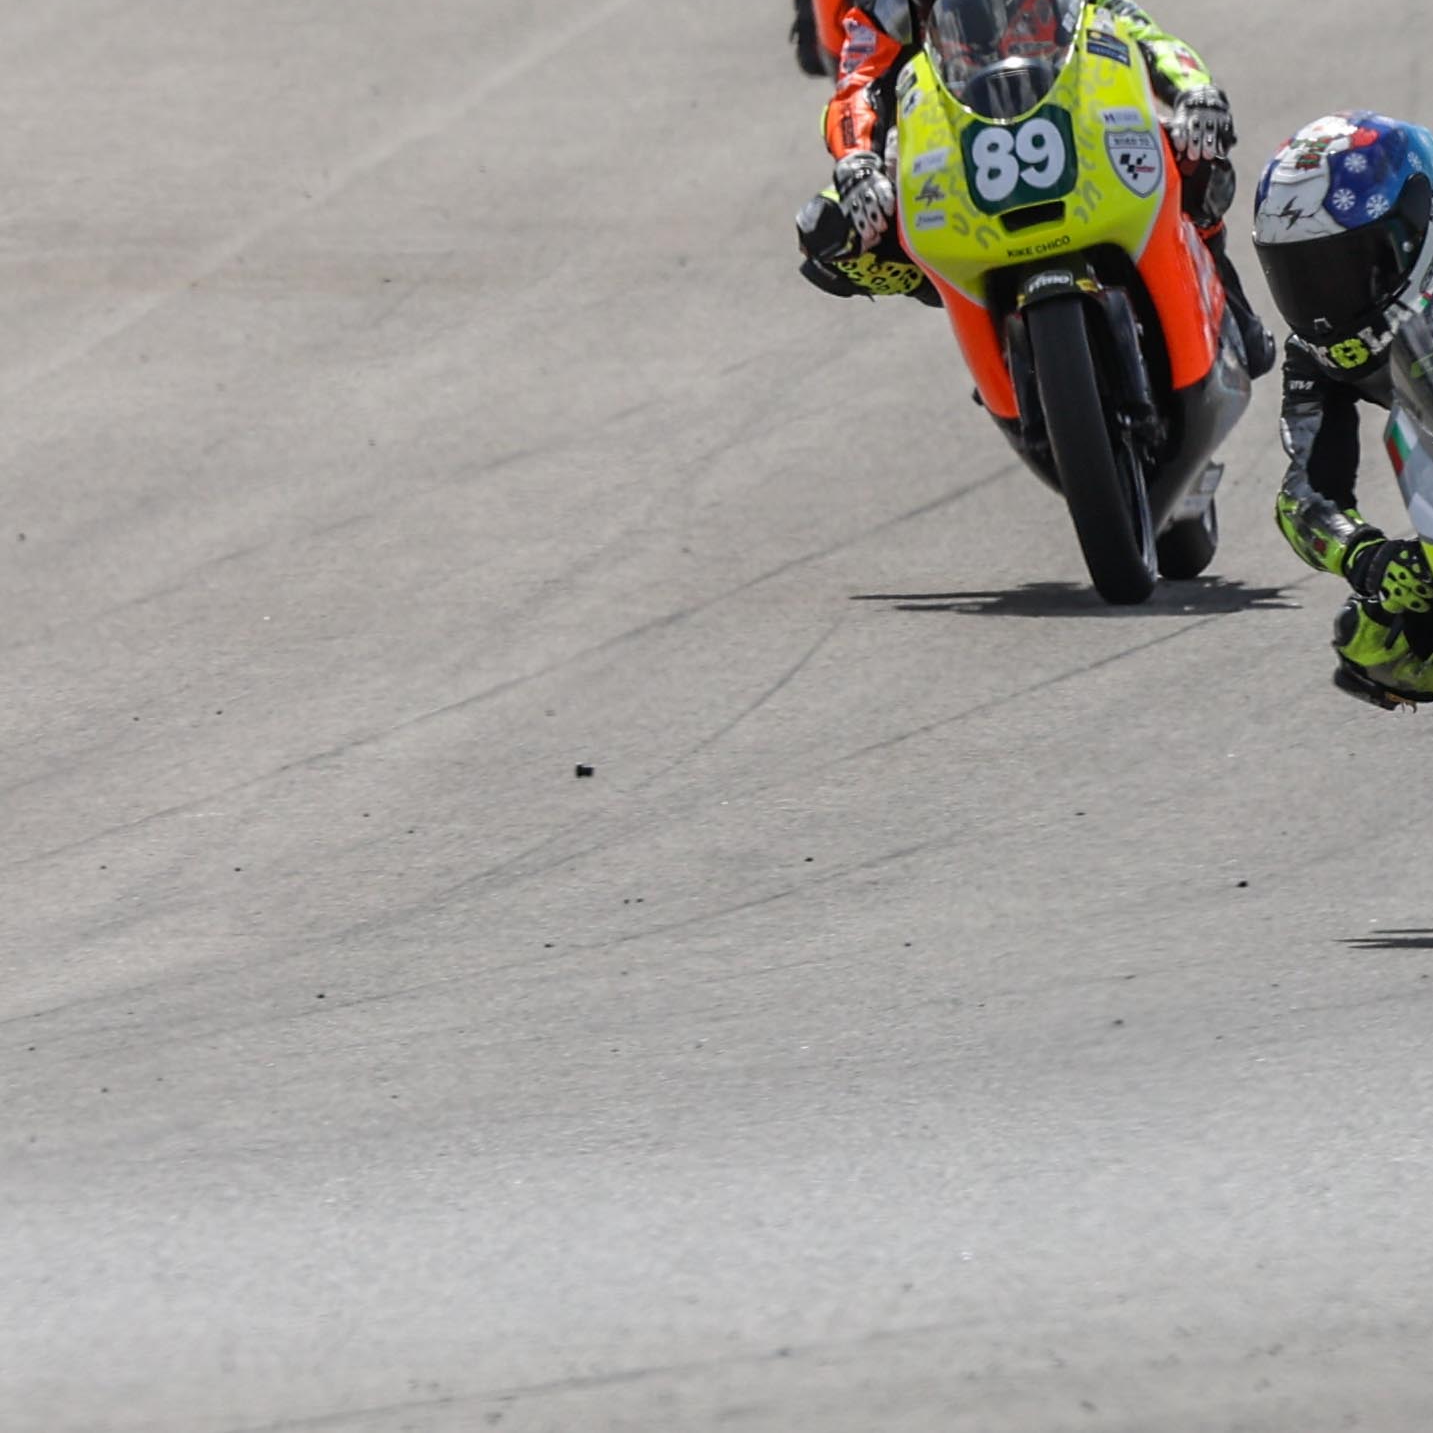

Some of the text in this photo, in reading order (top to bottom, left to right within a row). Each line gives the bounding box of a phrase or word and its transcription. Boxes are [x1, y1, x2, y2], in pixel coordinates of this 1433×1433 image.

[970, 116, 1067, 203] 89
[1007, 235, 1071, 258] KIKE CHICO
